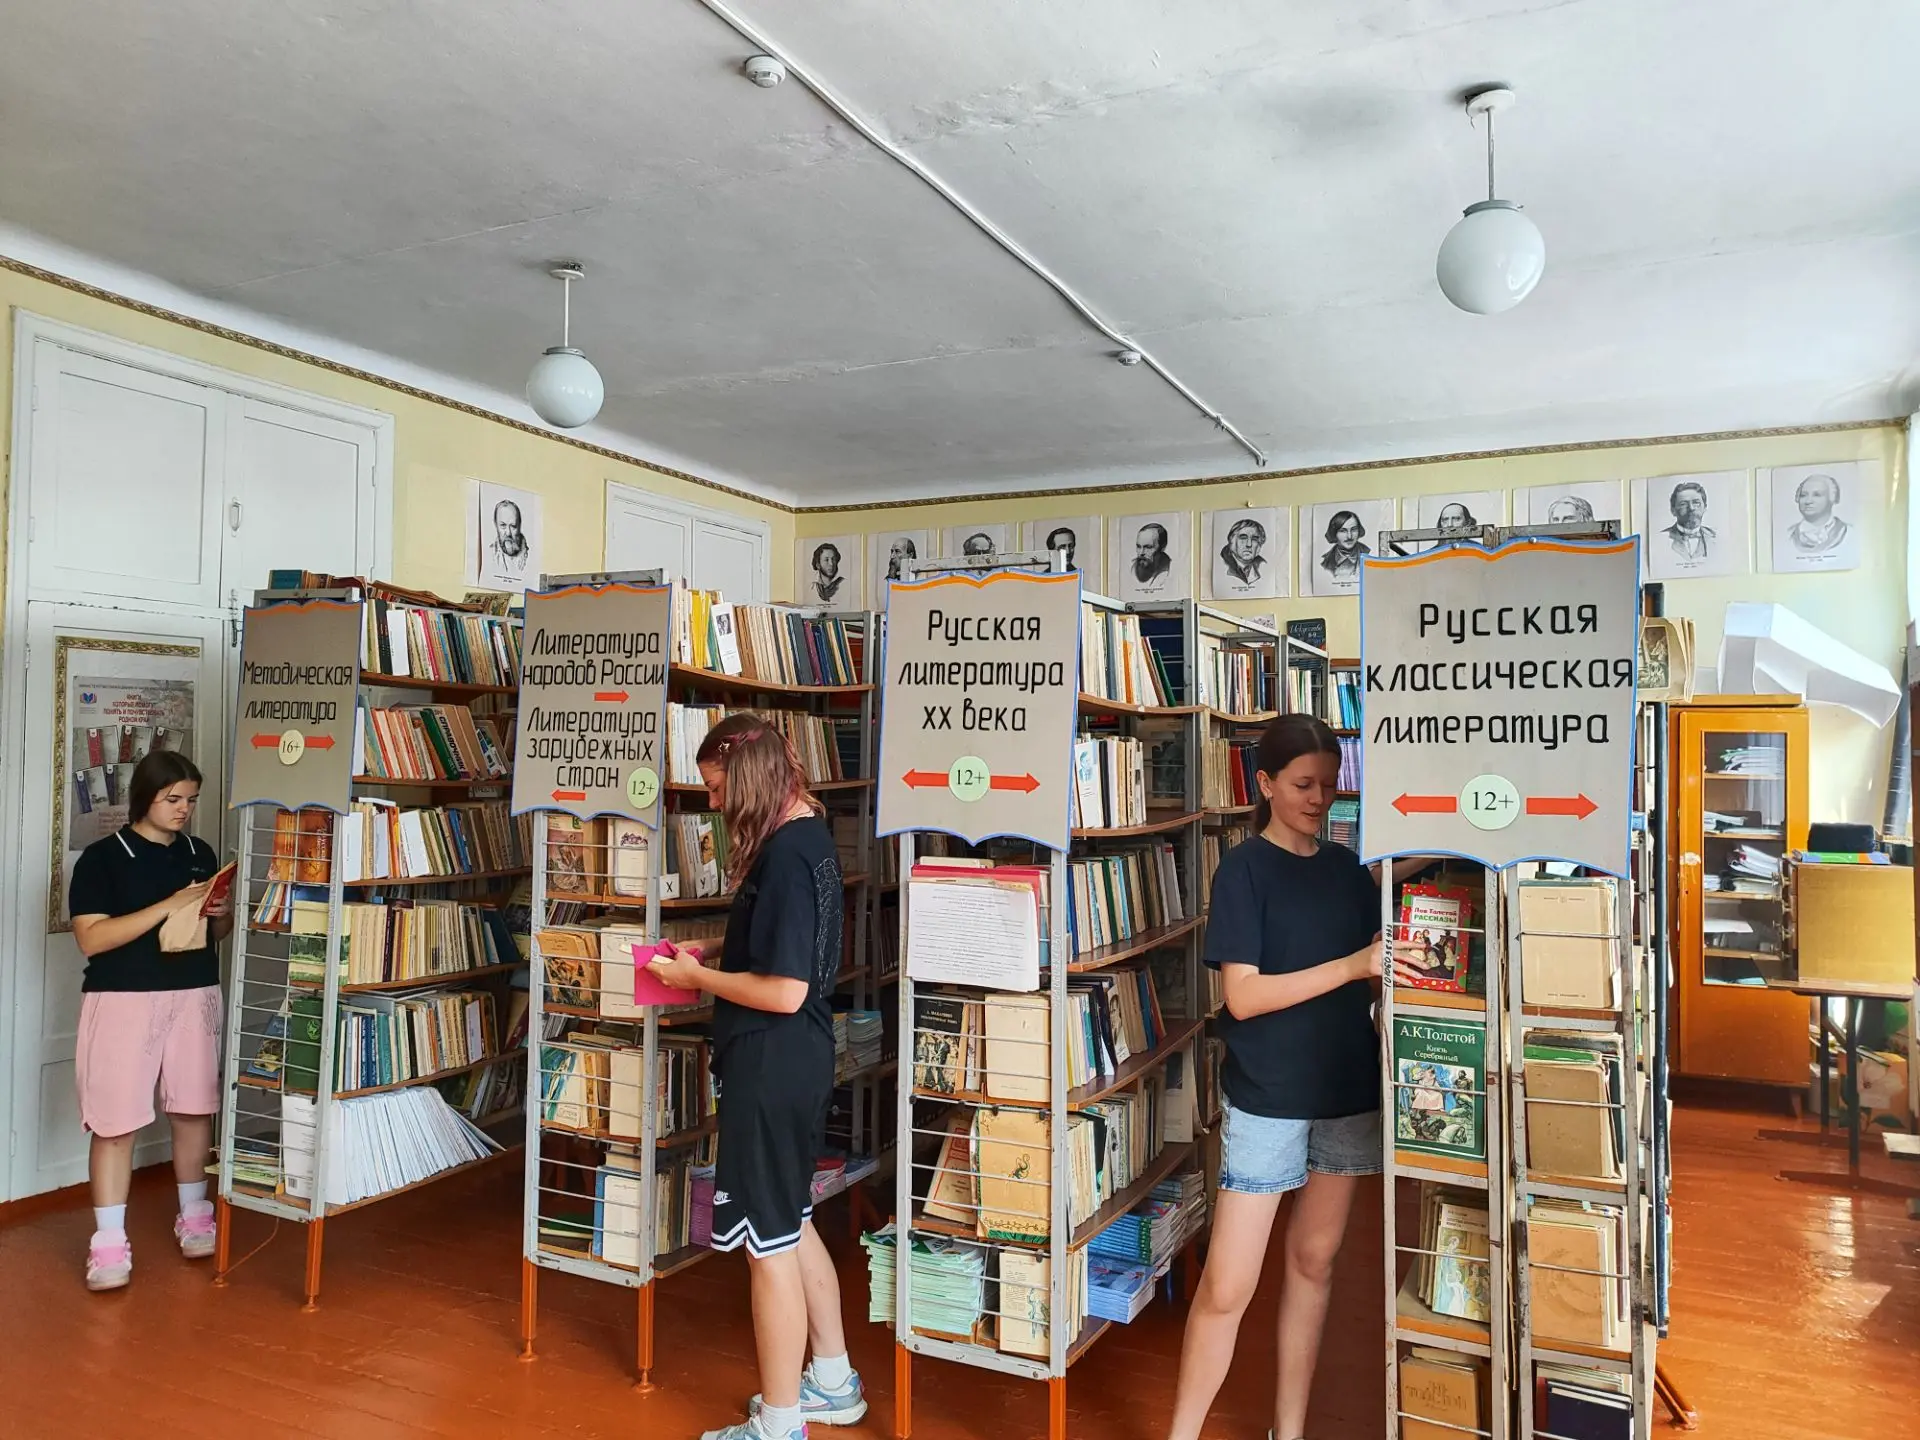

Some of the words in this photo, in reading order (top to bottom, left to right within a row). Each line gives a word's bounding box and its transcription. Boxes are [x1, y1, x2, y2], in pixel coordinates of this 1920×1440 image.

[927, 609, 1041, 647] Русская
[1419, 603, 1598, 644] Русская
[531, 628, 660, 659] Литература
[243, 660, 353, 686] Методическая
[522, 659, 596, 690] народов
[601, 658, 665, 686] России
[898, 661, 1064, 694] литература
[1366, 658, 1634, 692] классическая
[244, 700, 337, 725] литература
[527, 706, 657, 738] Литература
[962, 698, 1027, 731] века
[1373, 714, 1610, 750] литература
[281, 740, 301, 754] 16+
[527, 735, 654, 763] зарубежных
[556, 765, 620, 790] стран
[631, 780, 656, 796] 12+
[956, 769, 985, 786] 12+
[1472, 791, 1515, 811] 12+
[1414, 914, 1457, 923] РАССКАЗЫ
[1429, 908, 1457, 916] Толстой
[1414, 1049, 1459, 1062] Серебряный
[1426, 1044, 1448, 1054] Князь
